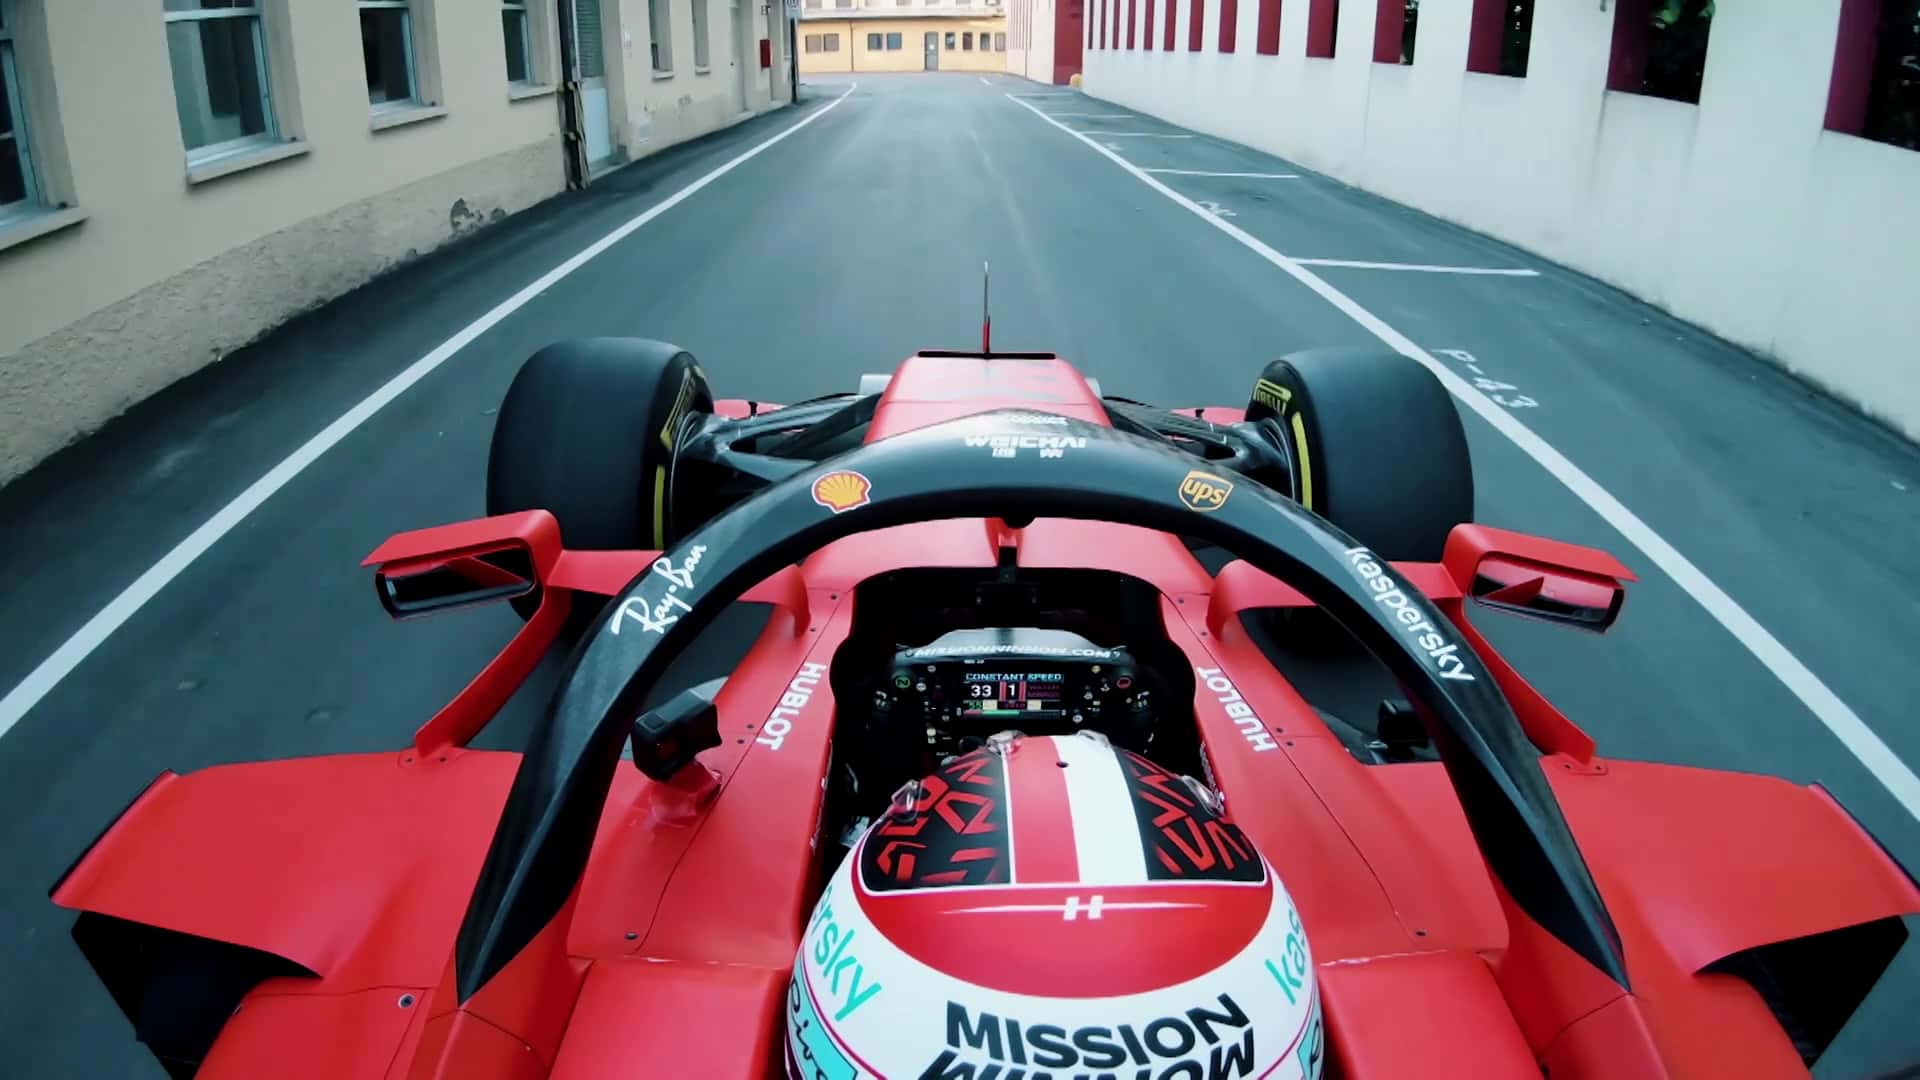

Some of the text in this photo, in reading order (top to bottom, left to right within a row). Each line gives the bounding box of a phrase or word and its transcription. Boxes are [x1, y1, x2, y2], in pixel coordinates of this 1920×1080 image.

[965, 435, 1087, 449] WEICHAI
[1184, 479, 1226, 504] ups
[1344, 547, 1475, 681] kaspersky
[965, 673, 1025, 681] CONSTANT
[970, 684, 992, 698] 33
[1008, 683, 1016, 697] 1
[756, 662, 827, 751] HUBLOT
[1197, 667, 1279, 752] HUBLOT
[947, 993, 1250, 1069] MISSION
